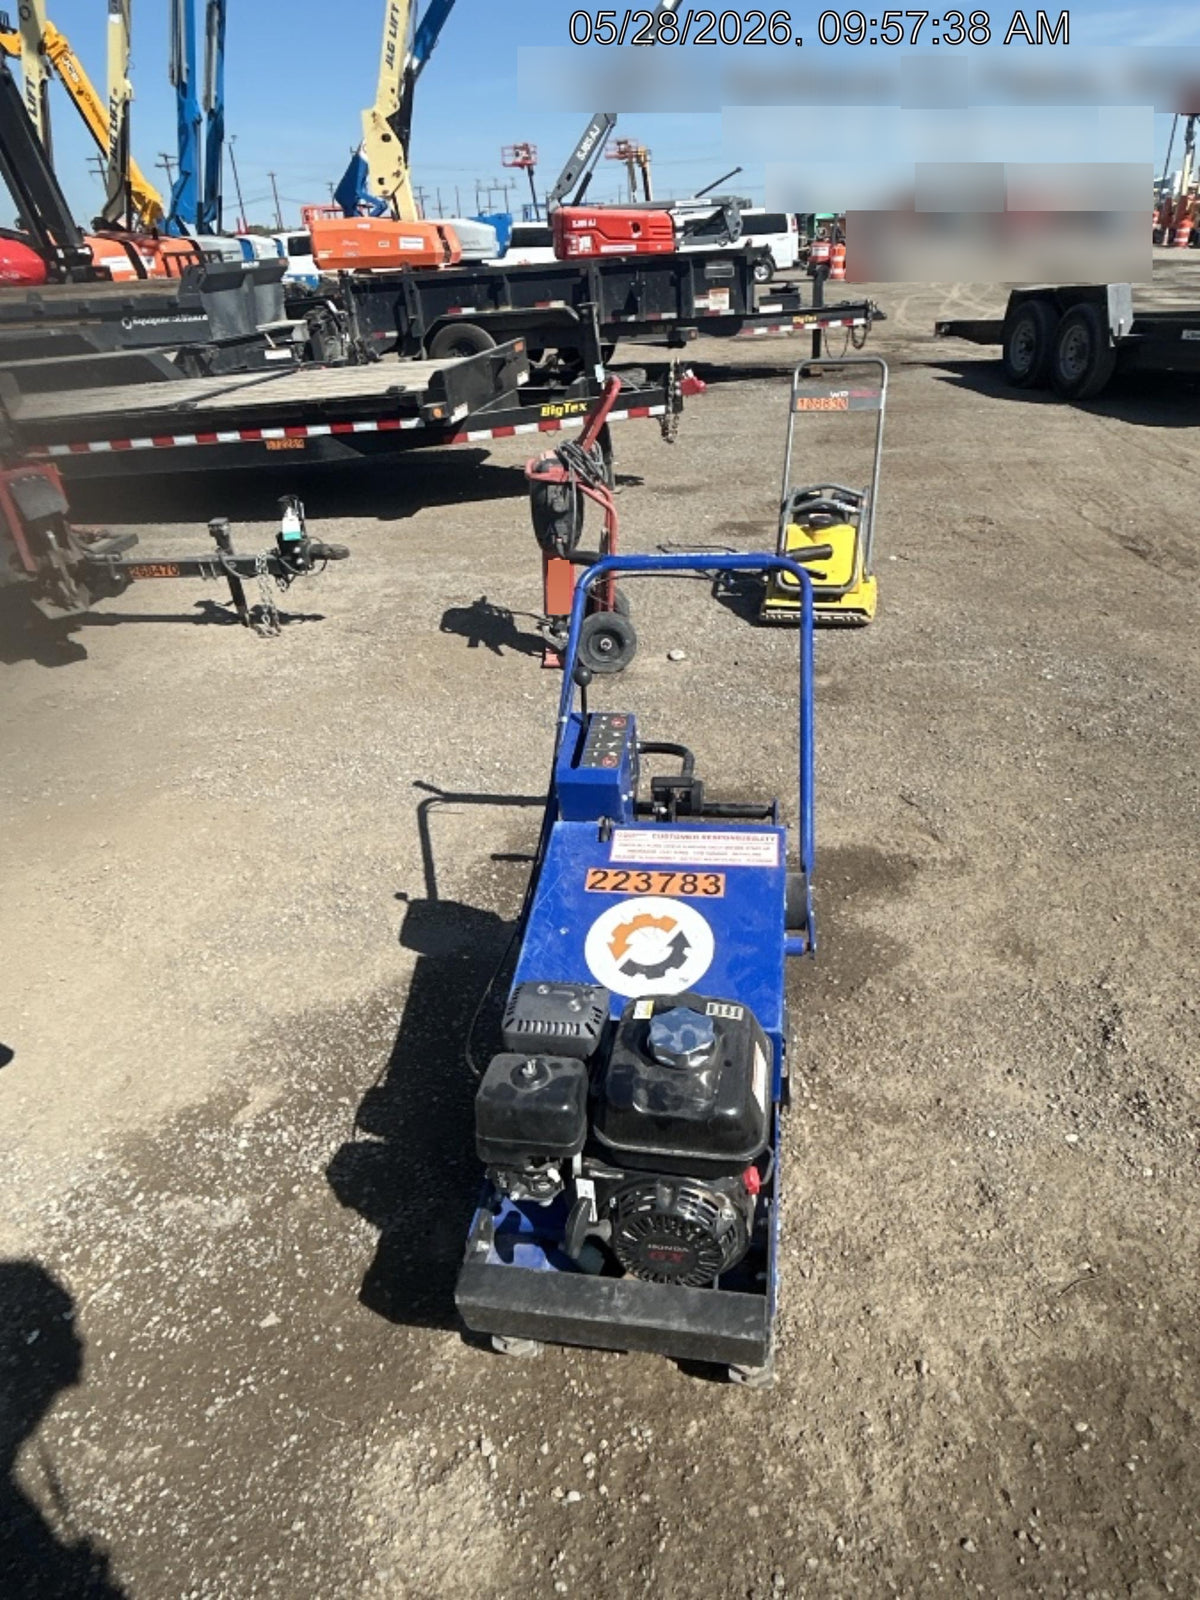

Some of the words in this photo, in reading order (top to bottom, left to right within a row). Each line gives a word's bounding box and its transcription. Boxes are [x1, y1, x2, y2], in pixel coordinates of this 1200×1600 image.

[389, 3, 399, 39] LIFT
[385, 41, 395, 70] JLG
[25, 76, 38, 118] LIFT
[109, 96, 120, 130] LIFT
[588, 869, 722, 895] 223783
